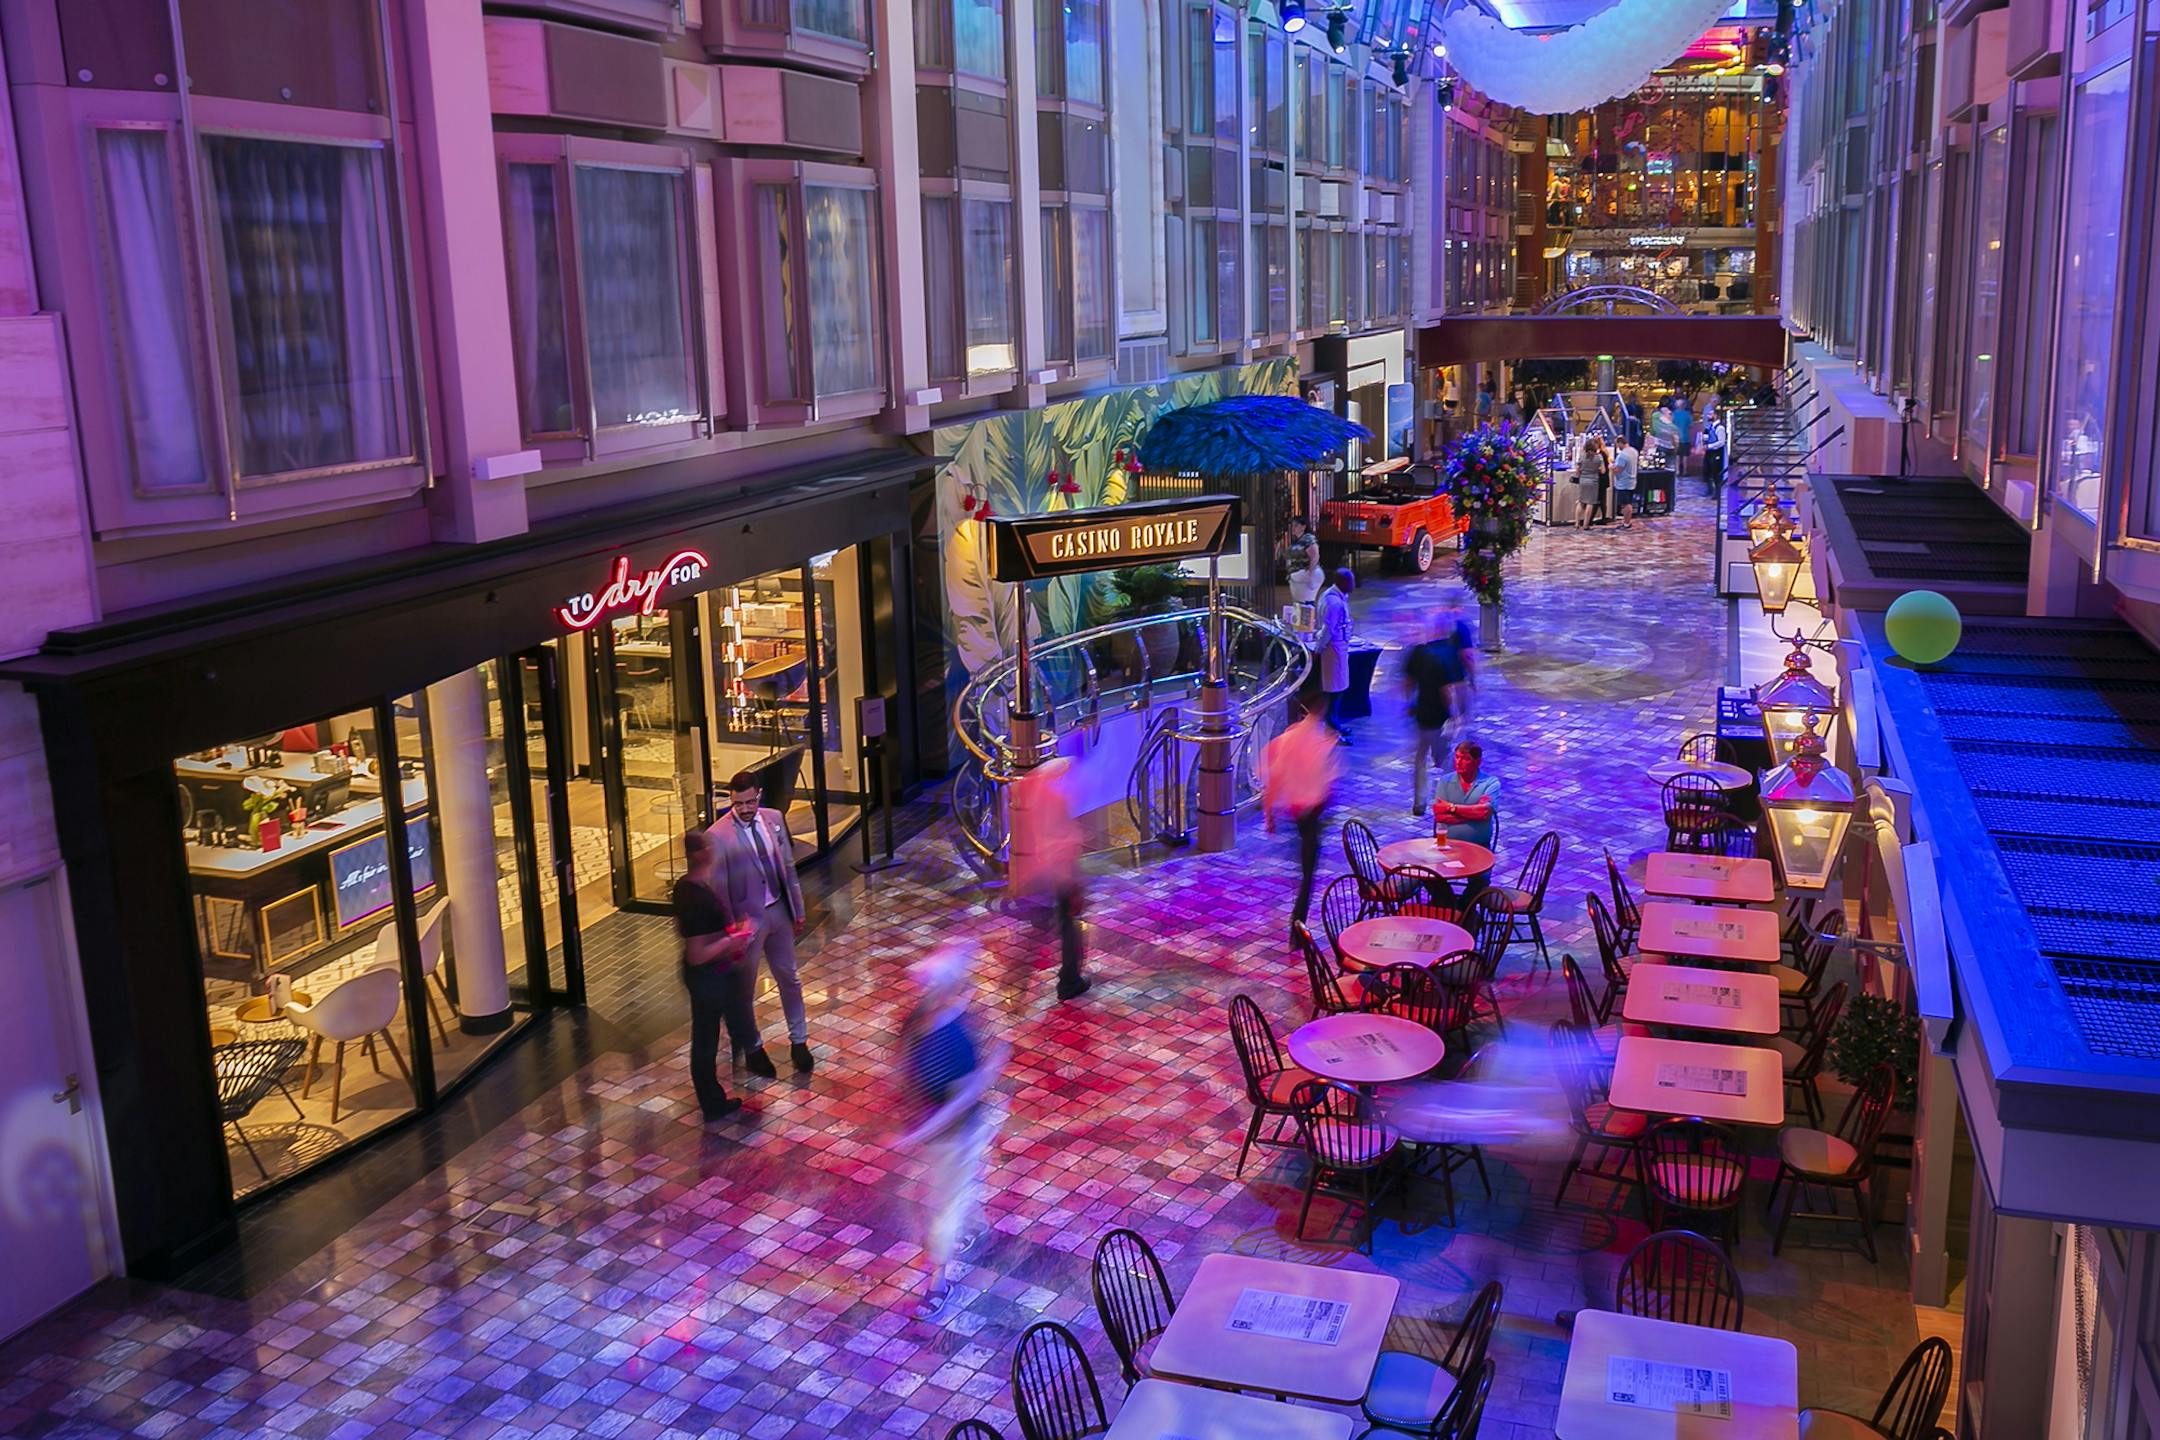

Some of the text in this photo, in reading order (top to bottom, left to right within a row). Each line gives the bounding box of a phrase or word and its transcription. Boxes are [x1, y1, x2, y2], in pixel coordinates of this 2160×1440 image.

[1052, 519, 1198, 559] CASINO ROYALE
[569, 556, 701, 617] TO dry FOR
